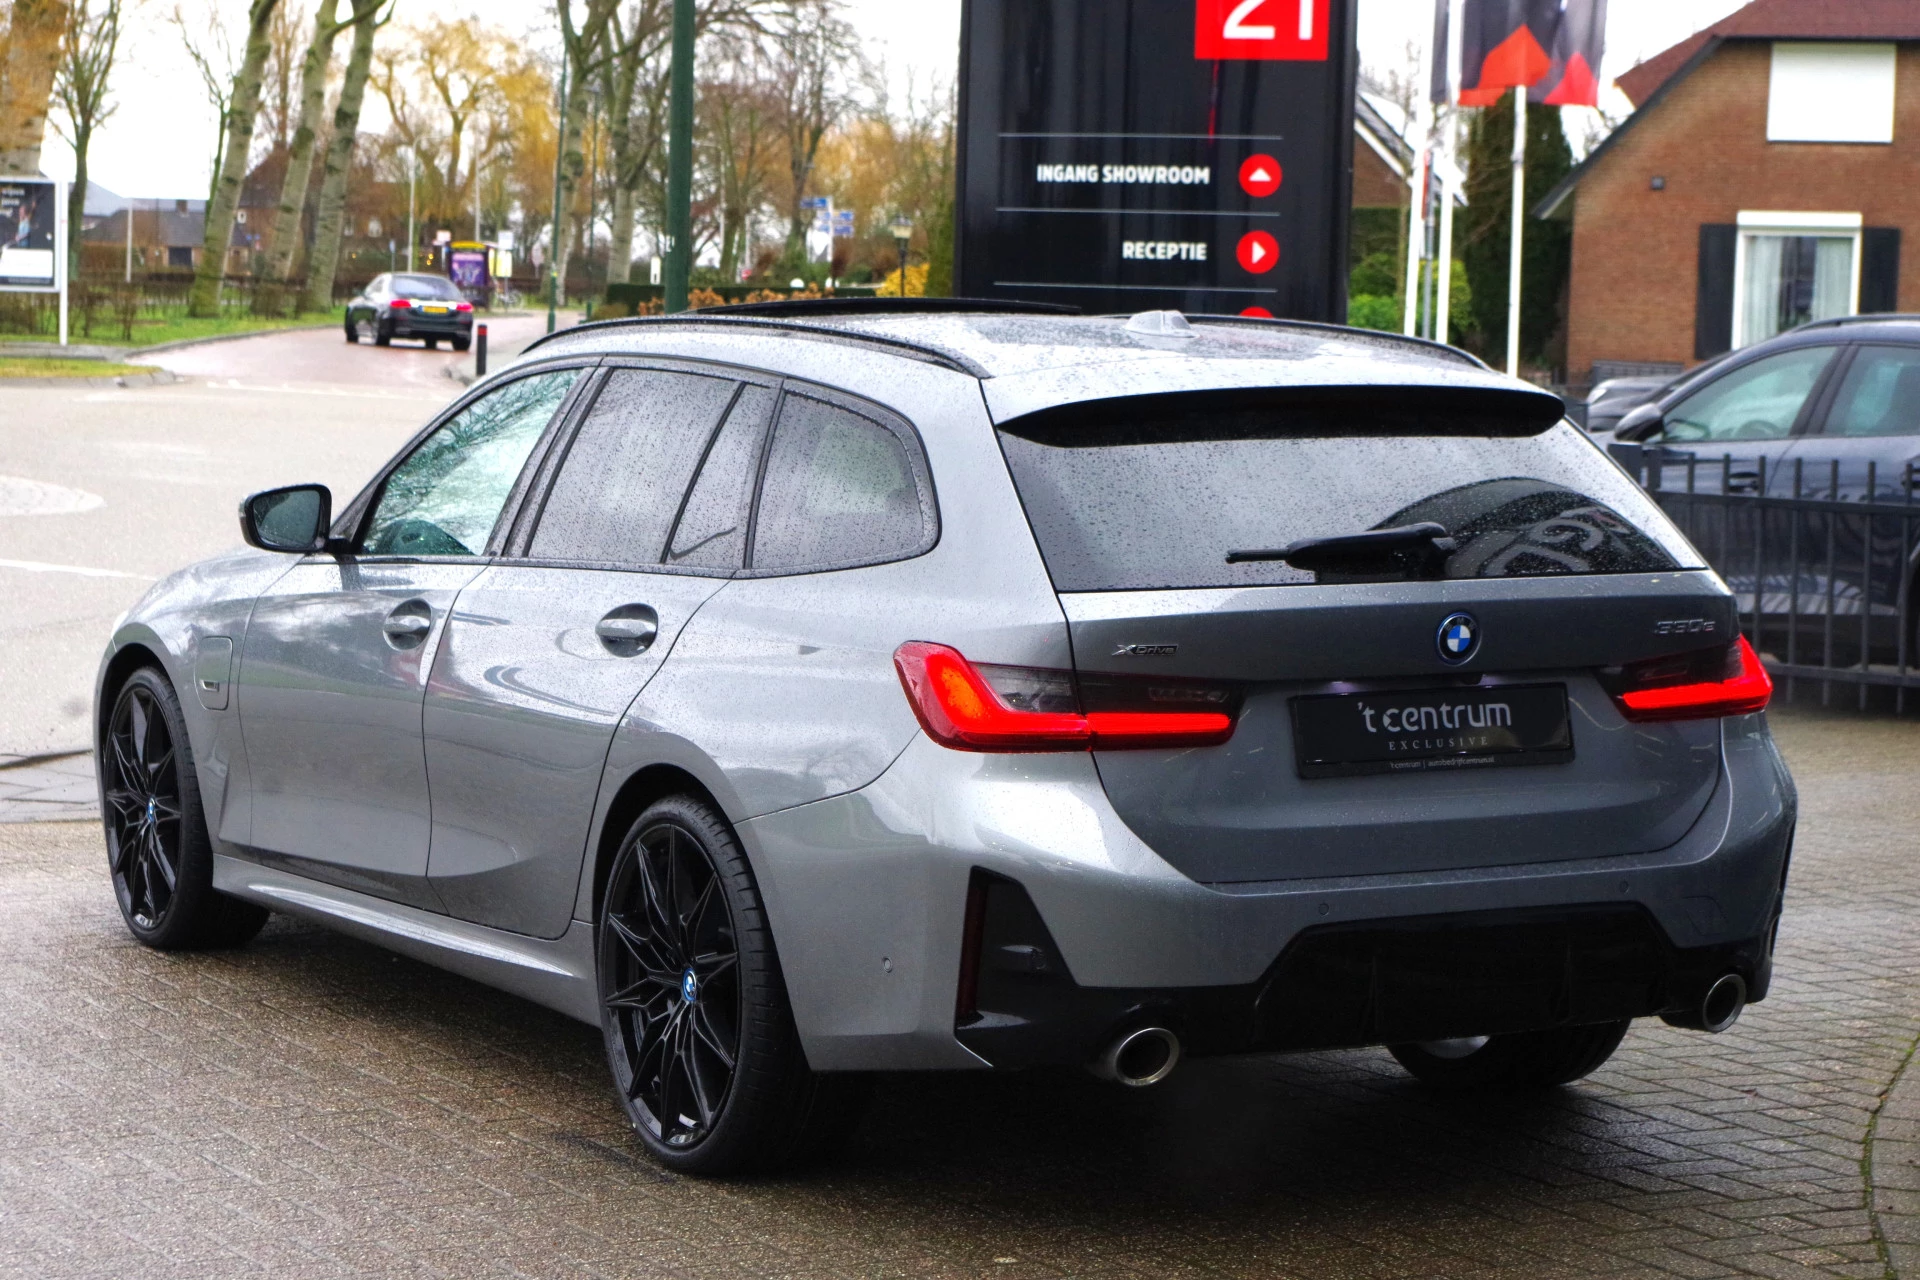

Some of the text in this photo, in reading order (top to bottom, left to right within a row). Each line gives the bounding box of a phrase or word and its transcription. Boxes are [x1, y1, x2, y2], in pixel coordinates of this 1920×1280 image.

[1036, 164, 1211, 185] INGANG SHOWROOM
[1122, 241, 1208, 261] RECEPTIE
[1382, 702, 1512, 733] centrum
[1388, 736, 1489, 751] EXCLUSIVE
